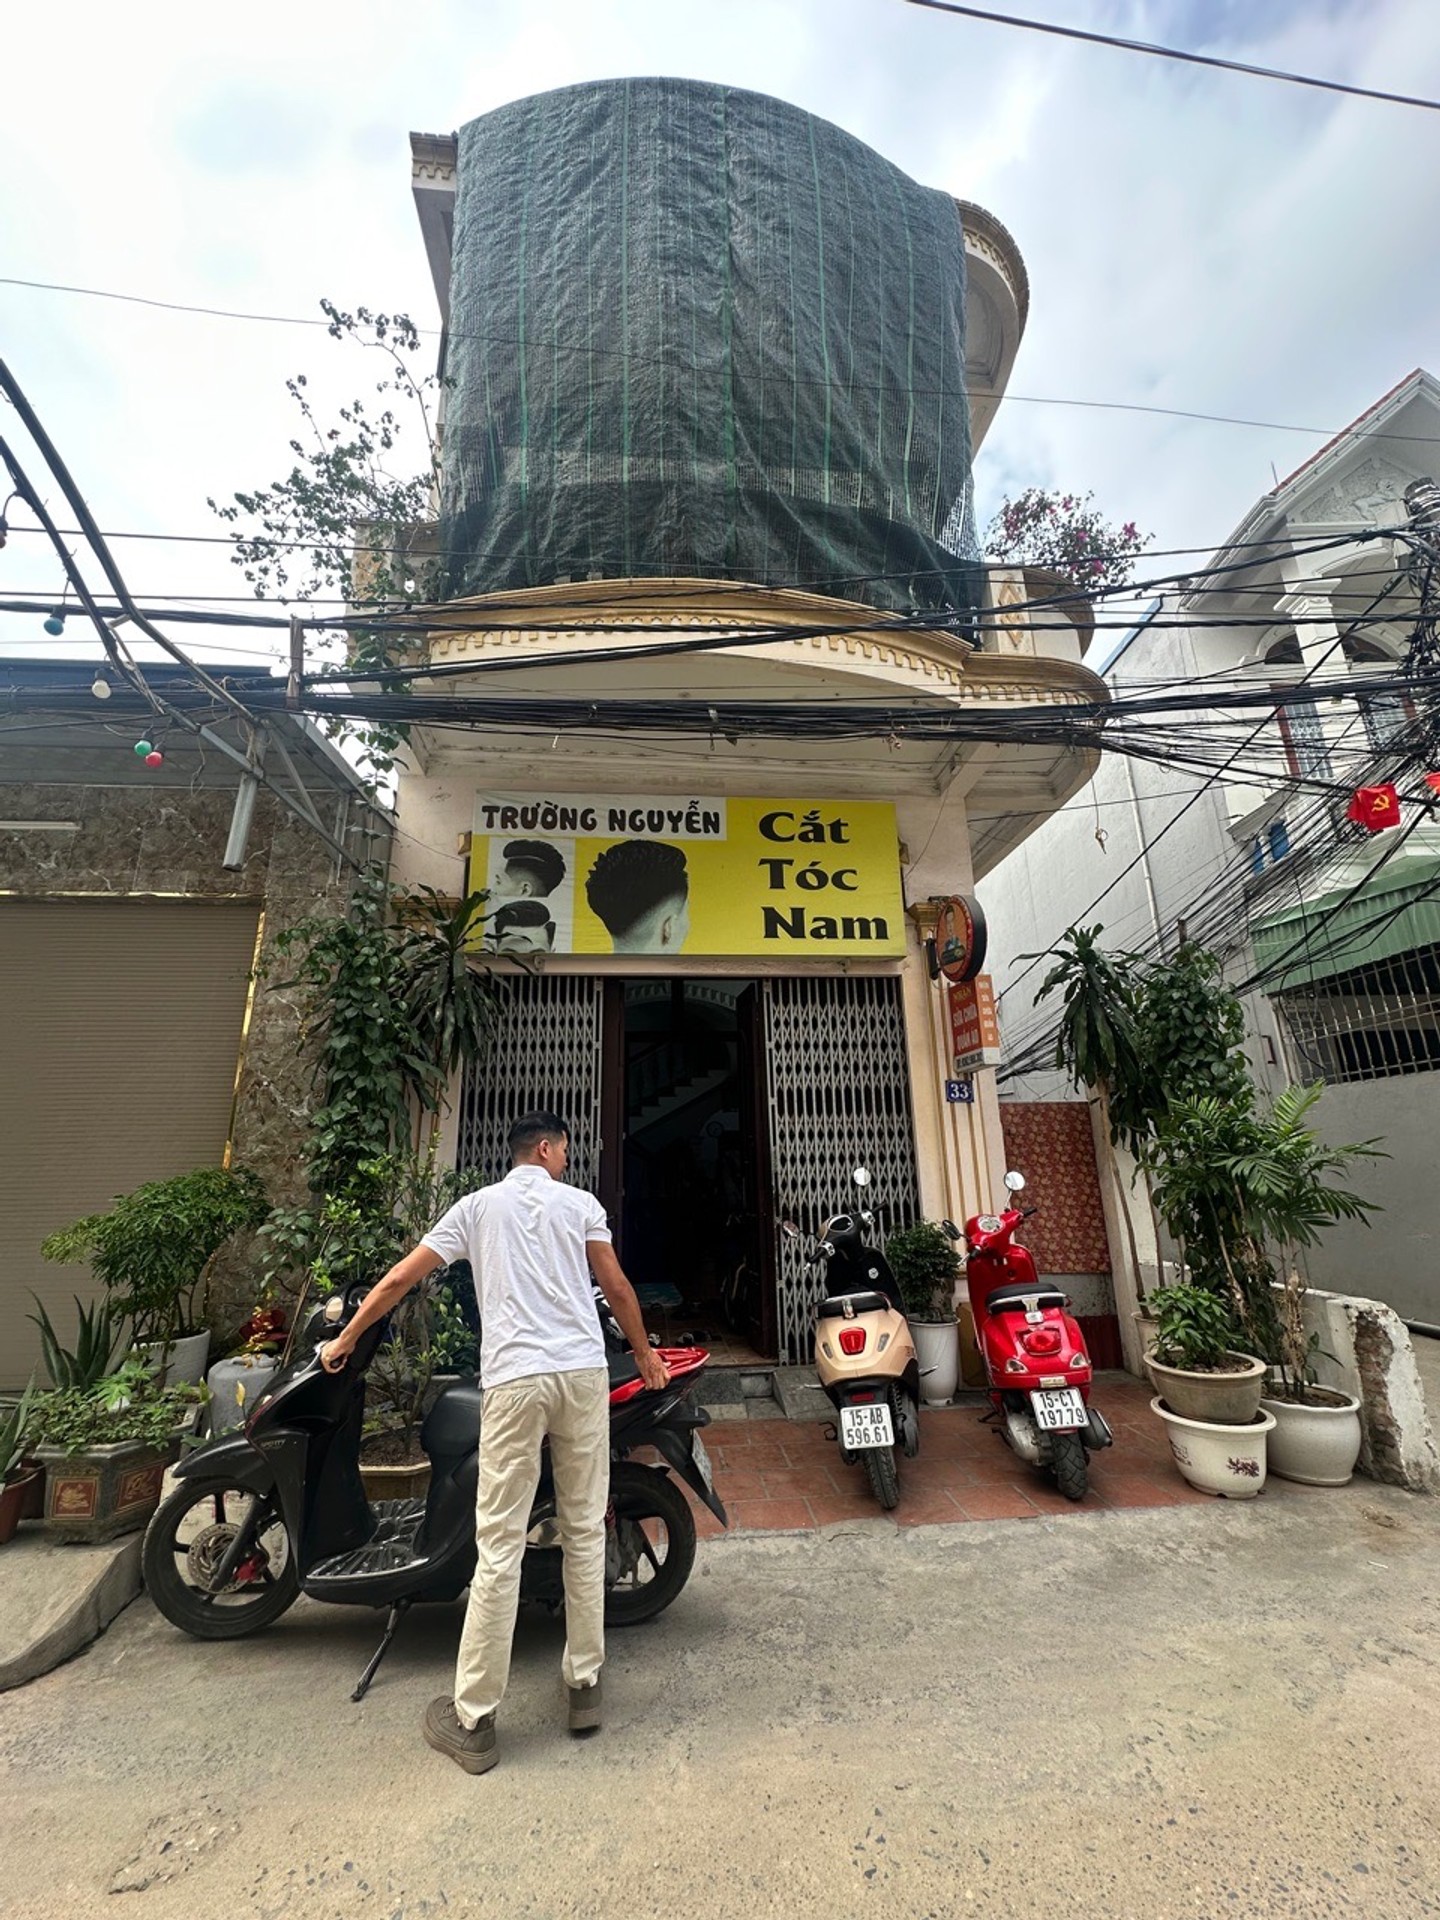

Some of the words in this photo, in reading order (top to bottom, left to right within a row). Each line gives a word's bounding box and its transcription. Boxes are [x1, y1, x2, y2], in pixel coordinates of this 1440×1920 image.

[481, 800, 598, 833] TRƯỜNG
[608, 800, 721, 835] NGUYỄN
[758, 809, 851, 845] Cắt
[758, 857, 859, 892] Tóc
[760, 905, 890, 941] Nam
[950, 1082, 969, 1099] 33
[1039, 1391, 1076, 1409] 15-C1
[849, 1407, 884, 1427] 15-AB
[1039, 1408, 1084, 1426] 197.79
[847, 1425, 890, 1446] 596.61
